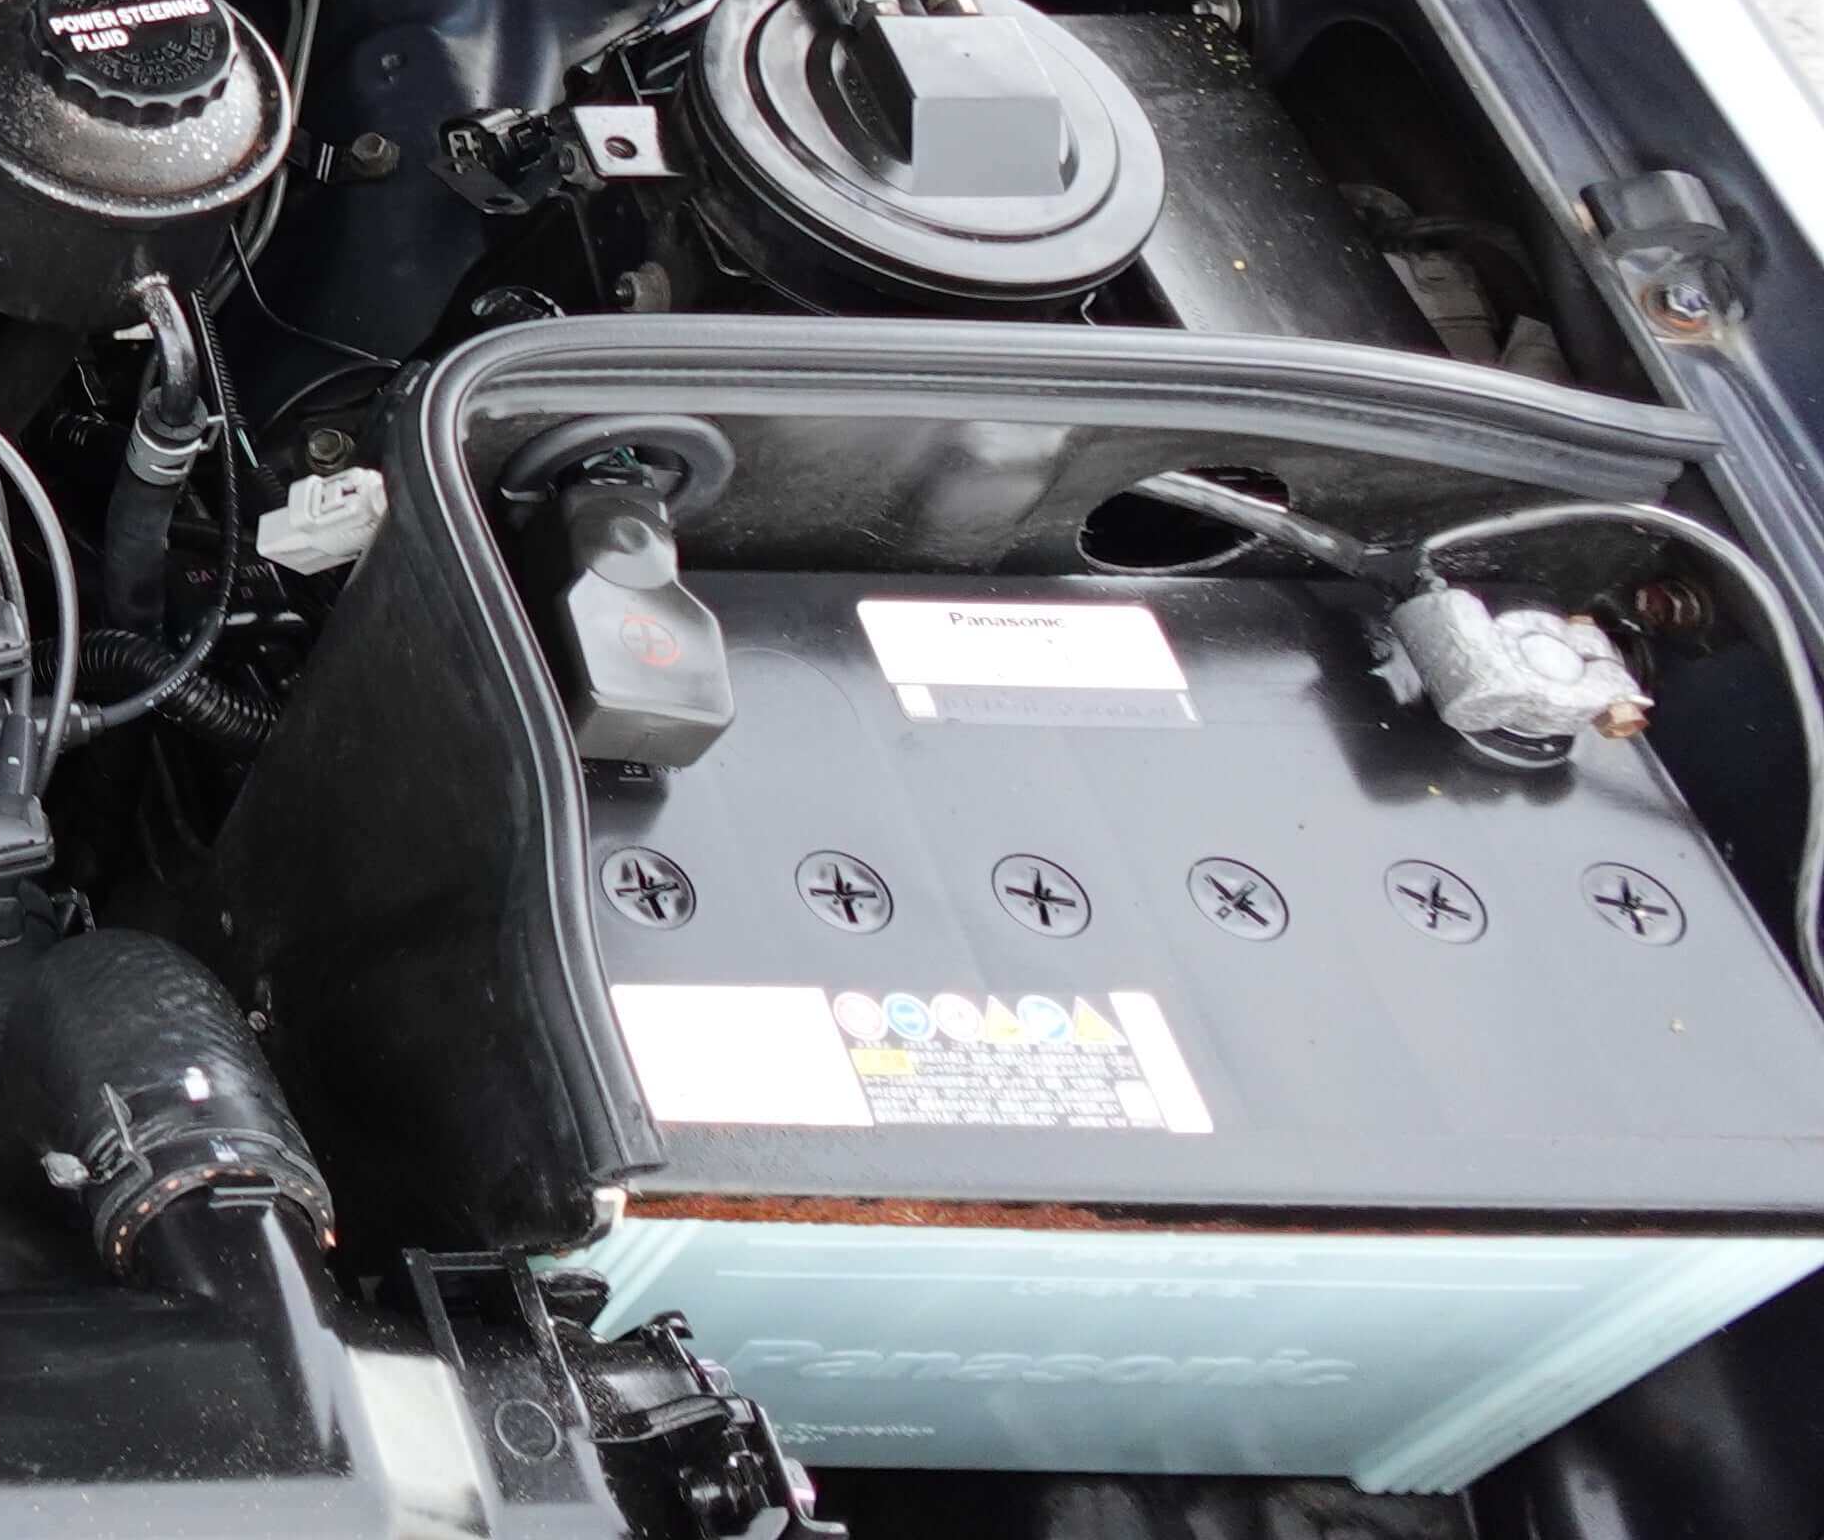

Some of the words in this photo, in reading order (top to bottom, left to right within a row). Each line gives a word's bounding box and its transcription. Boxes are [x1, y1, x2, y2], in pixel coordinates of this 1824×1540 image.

[48, 7, 120, 37] POWER
[70, 28, 130, 53] FLUID
[949, 612, 1067, 629] Panasonic
[727, 1337, 1358, 1386] Panasonic
